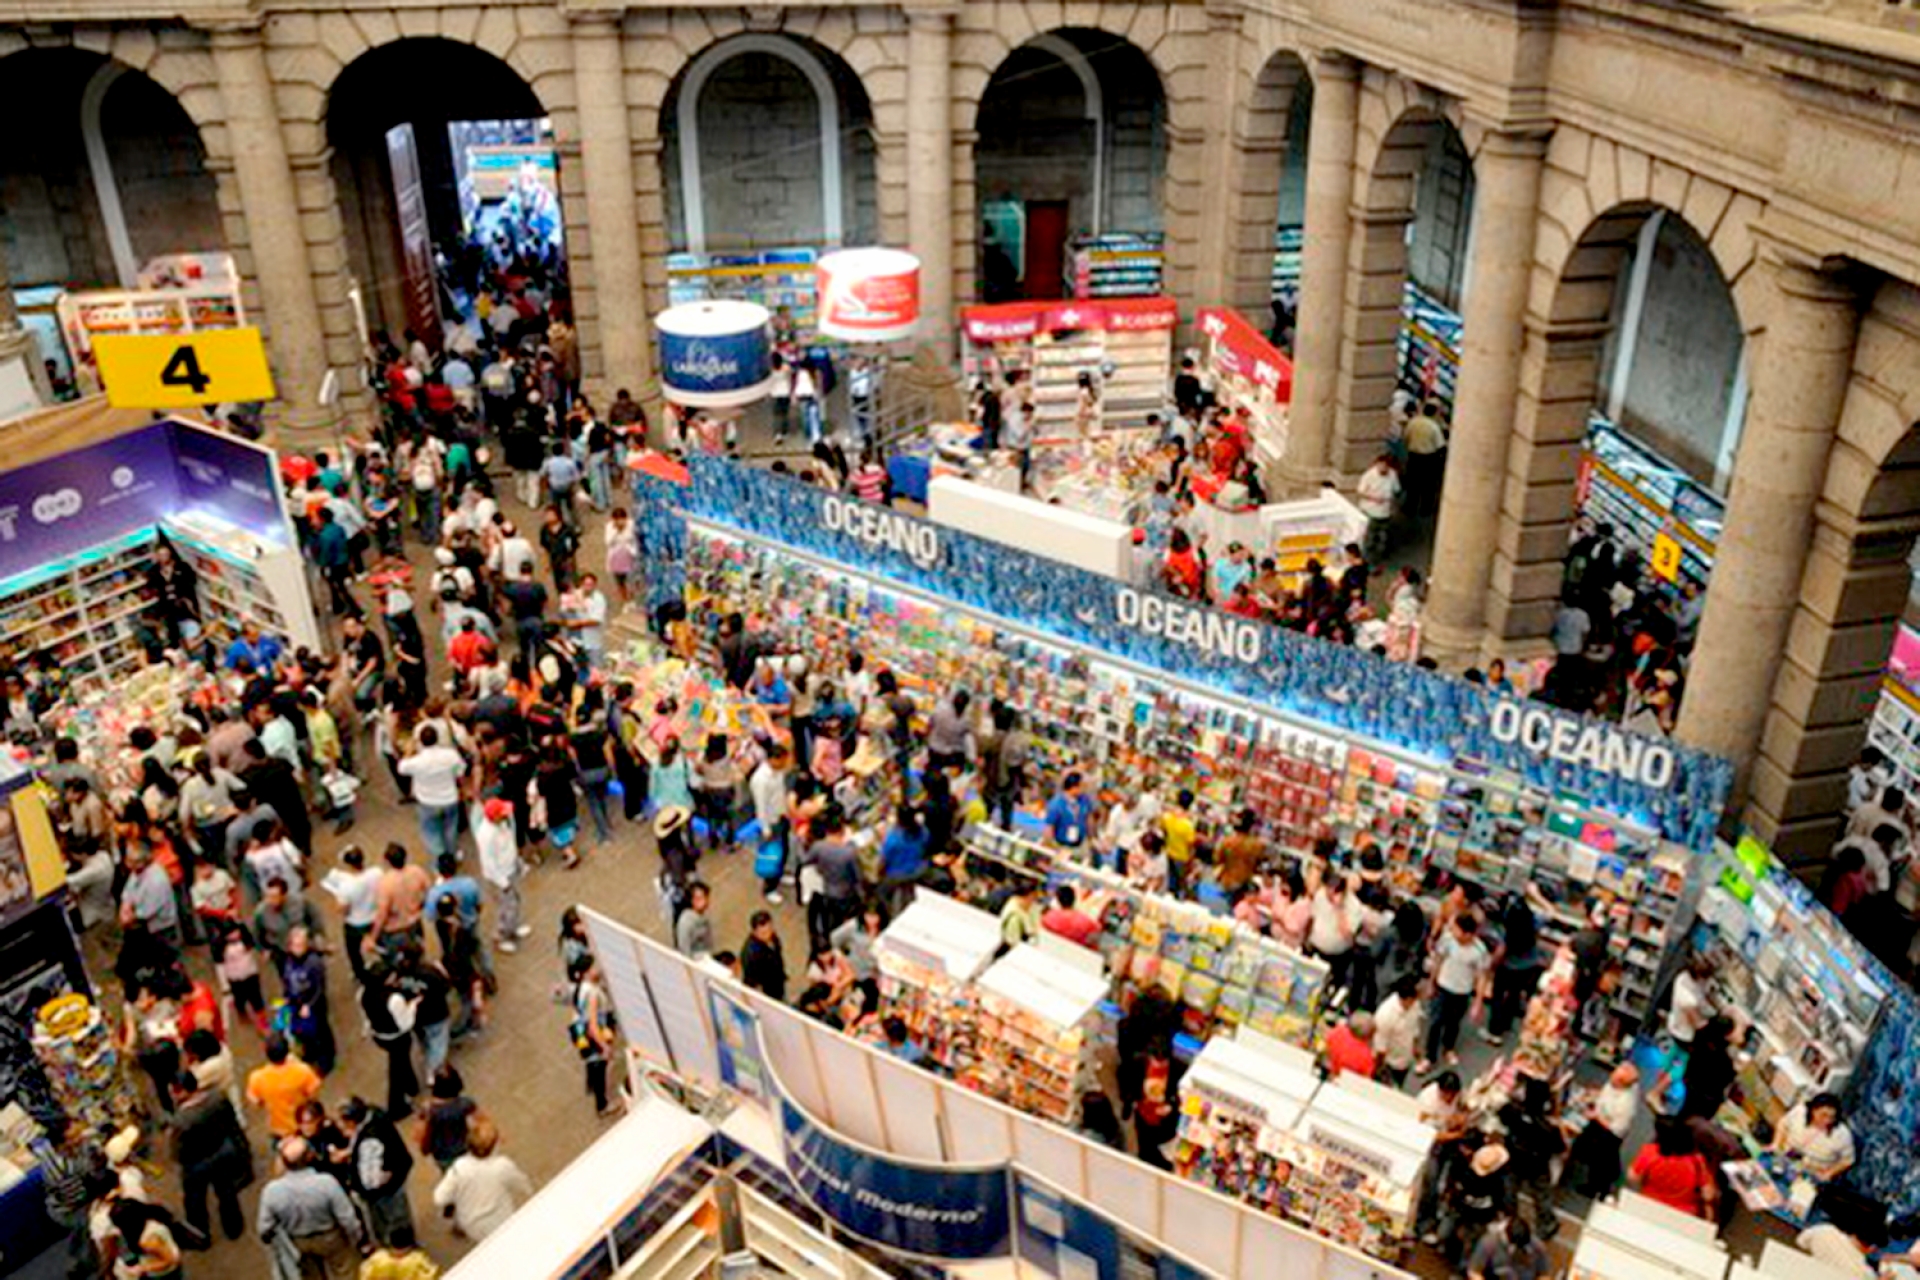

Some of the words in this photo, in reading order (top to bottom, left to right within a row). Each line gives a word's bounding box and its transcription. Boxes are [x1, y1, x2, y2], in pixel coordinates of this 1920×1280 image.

[160, 344, 211, 394] 4
[823, 496, 938, 561] OCEANO
[1116, 588, 1261, 664] OCEANO
[1490, 701, 1674, 788] OCEANO
